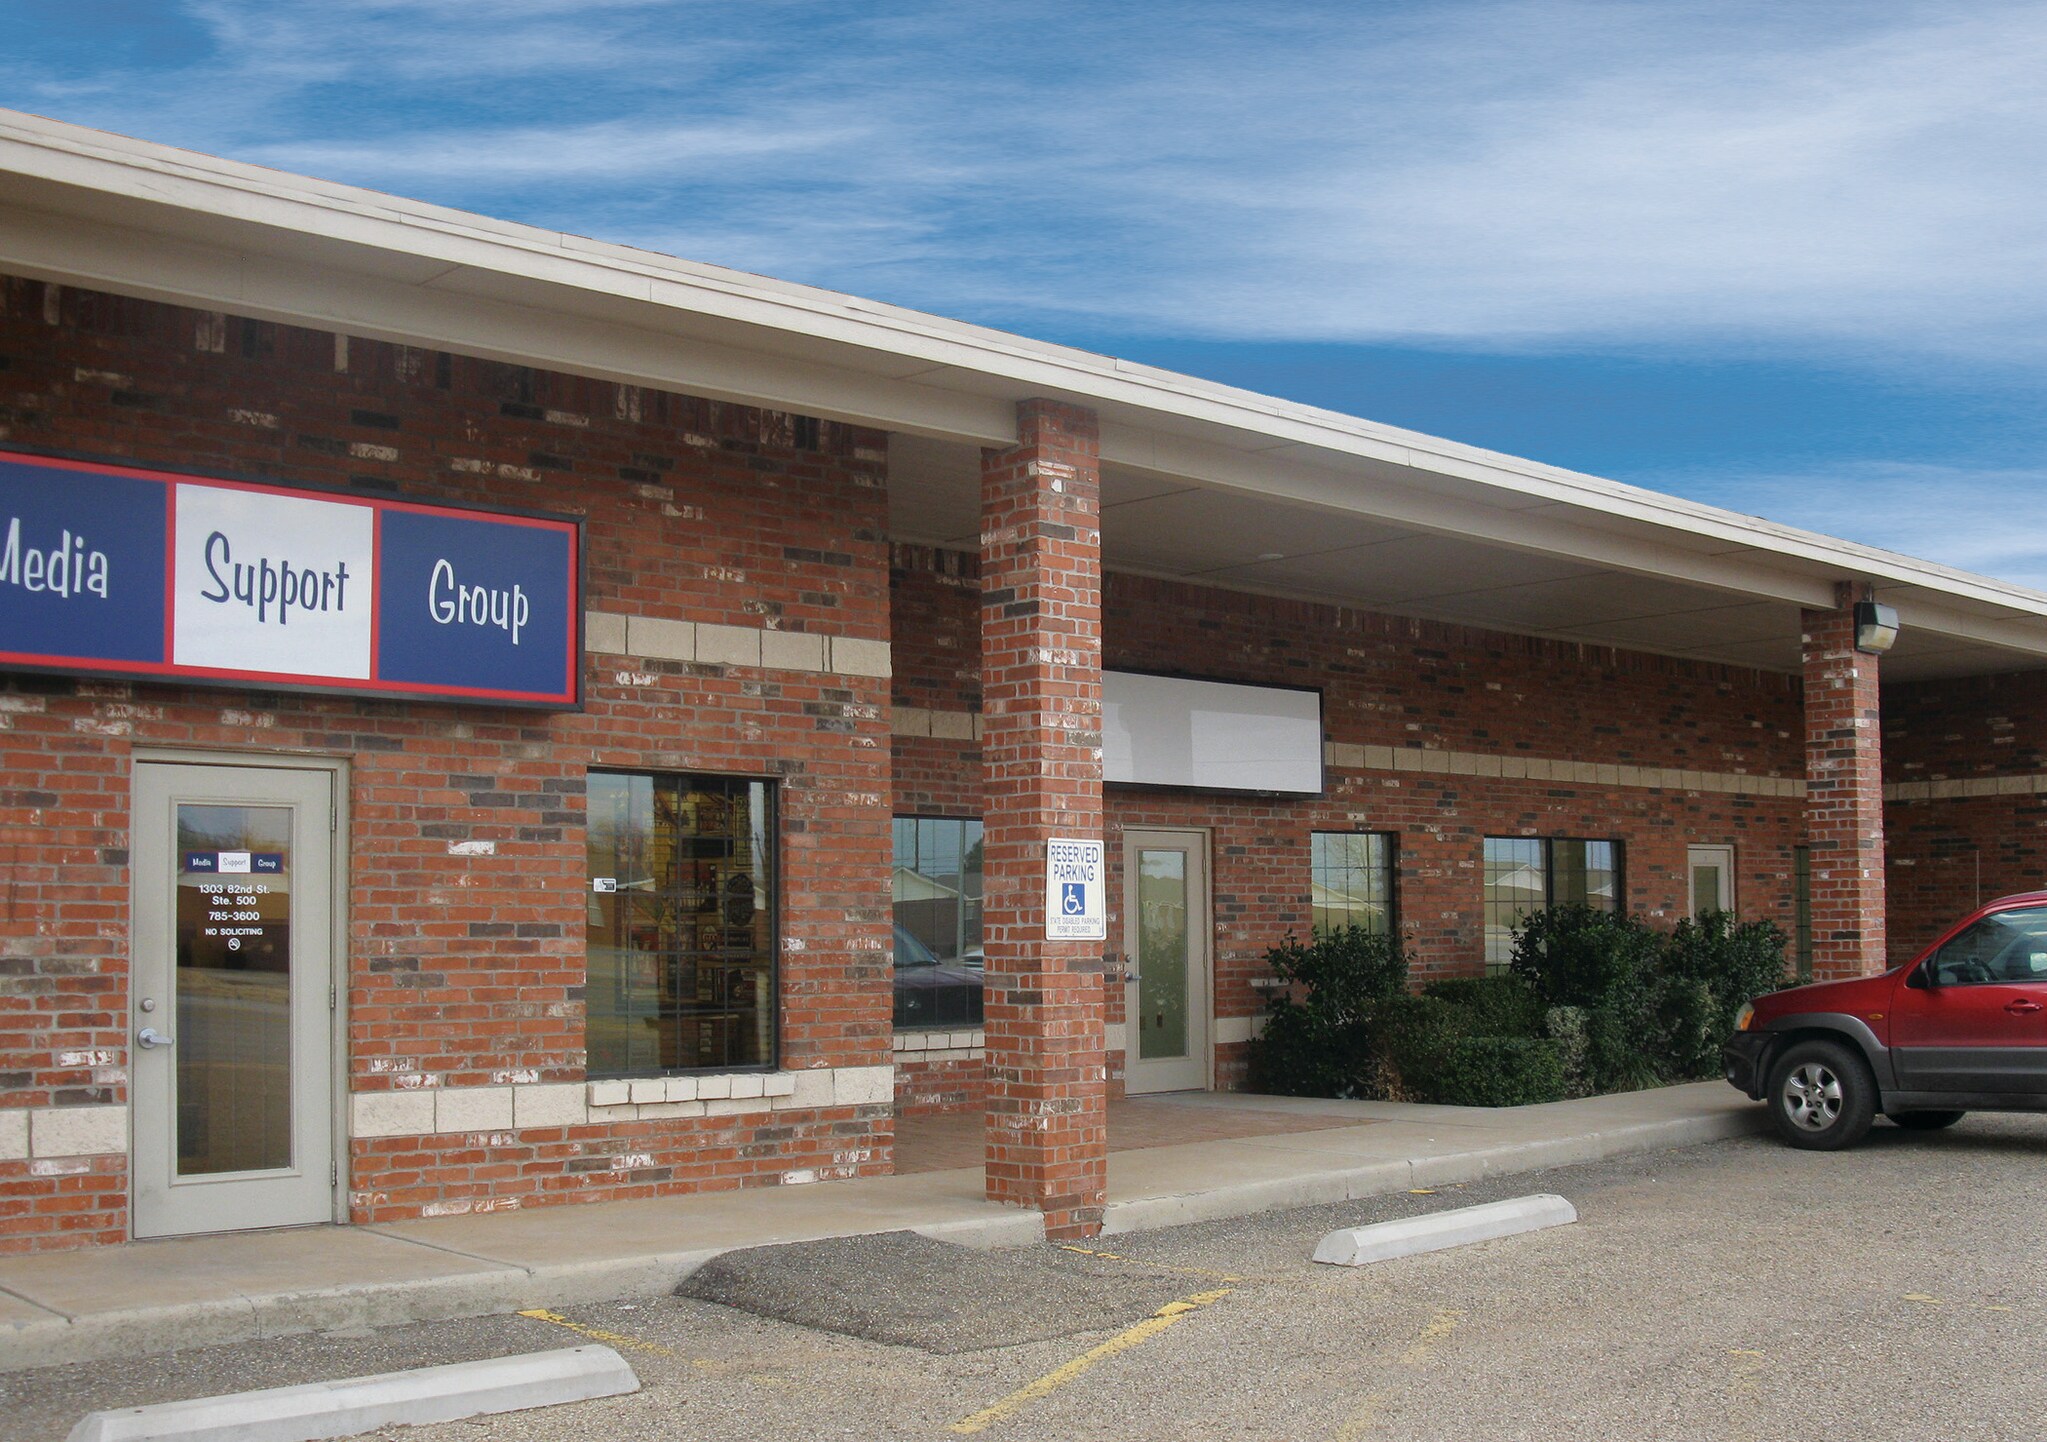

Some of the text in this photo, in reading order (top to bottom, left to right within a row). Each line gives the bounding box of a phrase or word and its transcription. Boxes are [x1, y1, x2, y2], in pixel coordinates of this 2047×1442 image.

[200, 530, 350, 625] Support
[428, 558, 530, 646] Group
[1051, 845, 1099, 863] RESERVED
[192, 857, 276, 869] Media Support Group
[1054, 864, 1095, 882] PARKING
[199, 884, 270, 894] 1303 82nd St.
[212, 896, 257, 905] Ste. 500
[208, 912, 259, 920] 785-3600
[205, 928, 263, 936] NO SOLICITING
